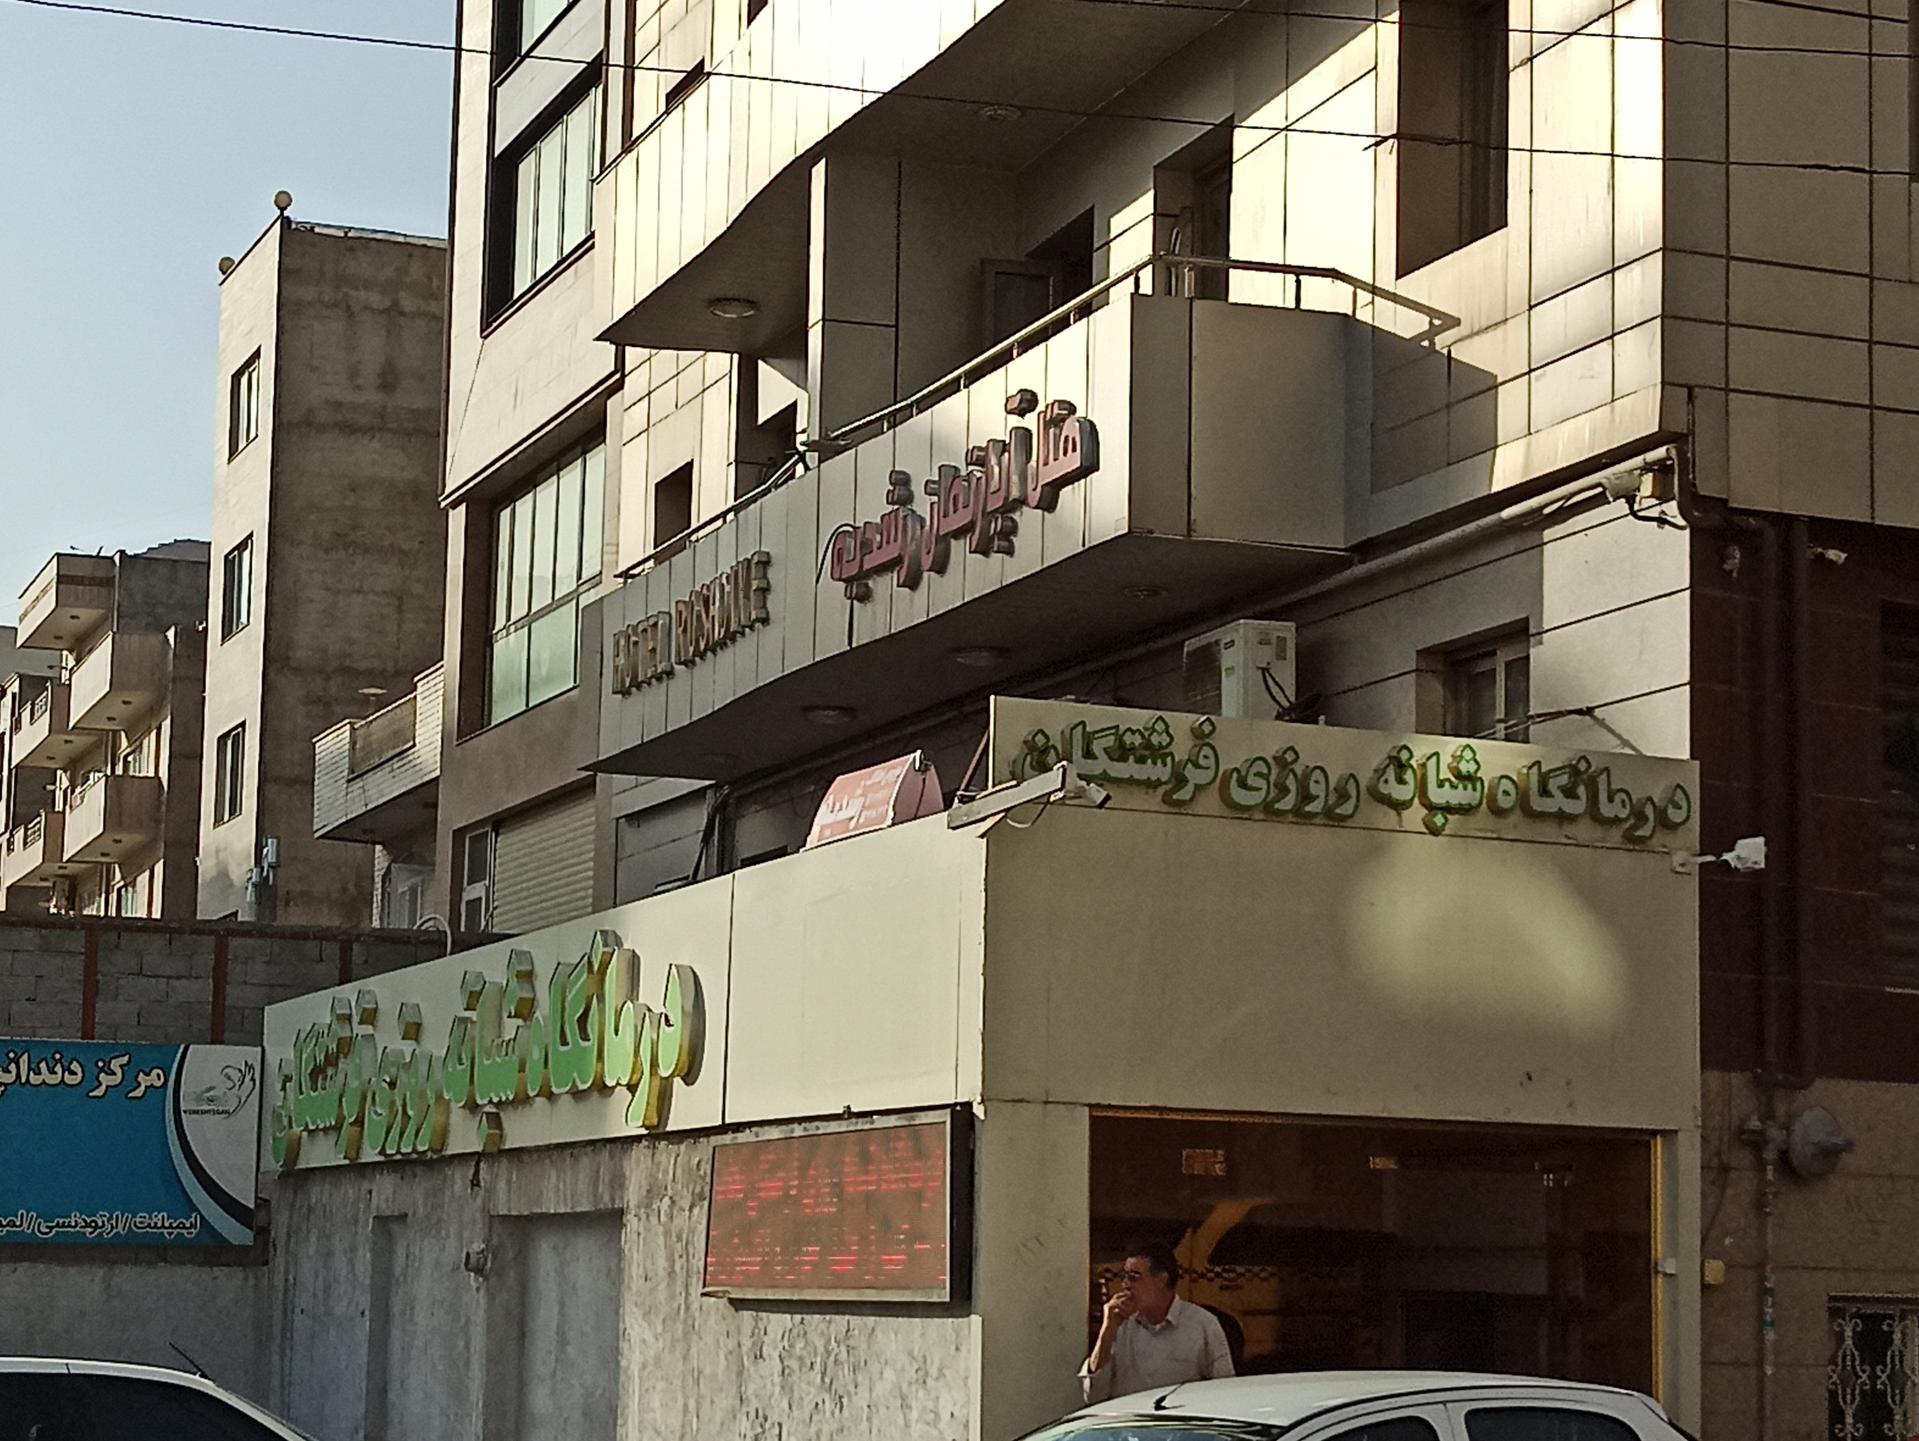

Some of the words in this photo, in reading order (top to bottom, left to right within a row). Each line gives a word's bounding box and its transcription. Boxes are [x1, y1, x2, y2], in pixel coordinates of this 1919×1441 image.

[1027, 400, 1099, 513] هتل
[831, 470, 926, 604] رشدیه
[612, 611, 674, 698] HOTEL
[1009, 715, 1219, 808] فرشتگان
[1219, 746, 1360, 820] روزی
[1367, 744, 1484, 836] شبانه
[1486, 755, 1691, 842] درمانگاه
[87, 1053, 165, 1098] مرکز
[270, 988, 378, 1168] فرشتگان
[366, 1002, 450, 1156] روزی
[443, 948, 537, 1151] شبانه
[528, 930, 706, 1130] درمانگاه
